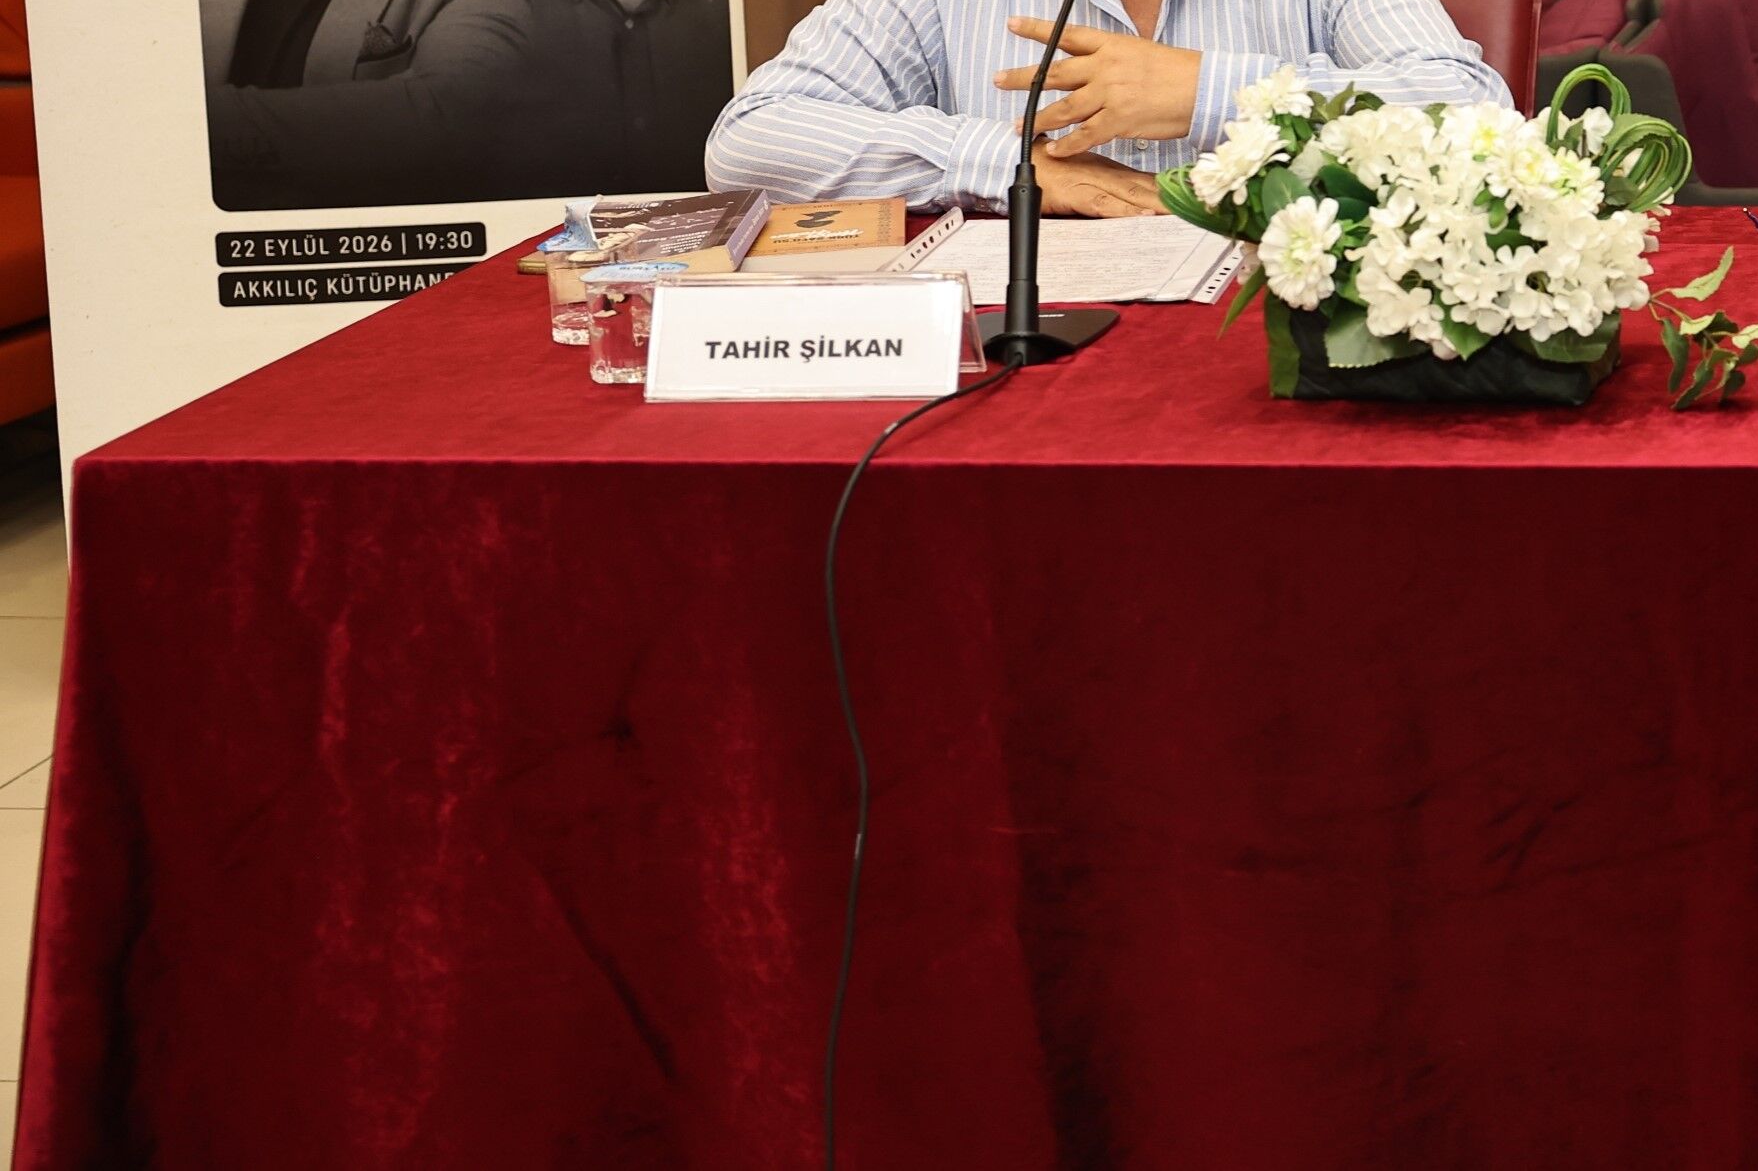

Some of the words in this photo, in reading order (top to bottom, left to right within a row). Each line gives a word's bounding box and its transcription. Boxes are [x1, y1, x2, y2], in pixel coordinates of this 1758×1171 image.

[230, 240, 256, 258] 22
[265, 234, 329, 256] EYLÜL
[339, 234, 393, 254] 2026
[415, 230, 473, 251] 19:30
[233, 278, 318, 301] AKKILIÇ
[705, 333, 790, 361] TAHİR
[800, 333, 904, 363] ŞİLKAN
